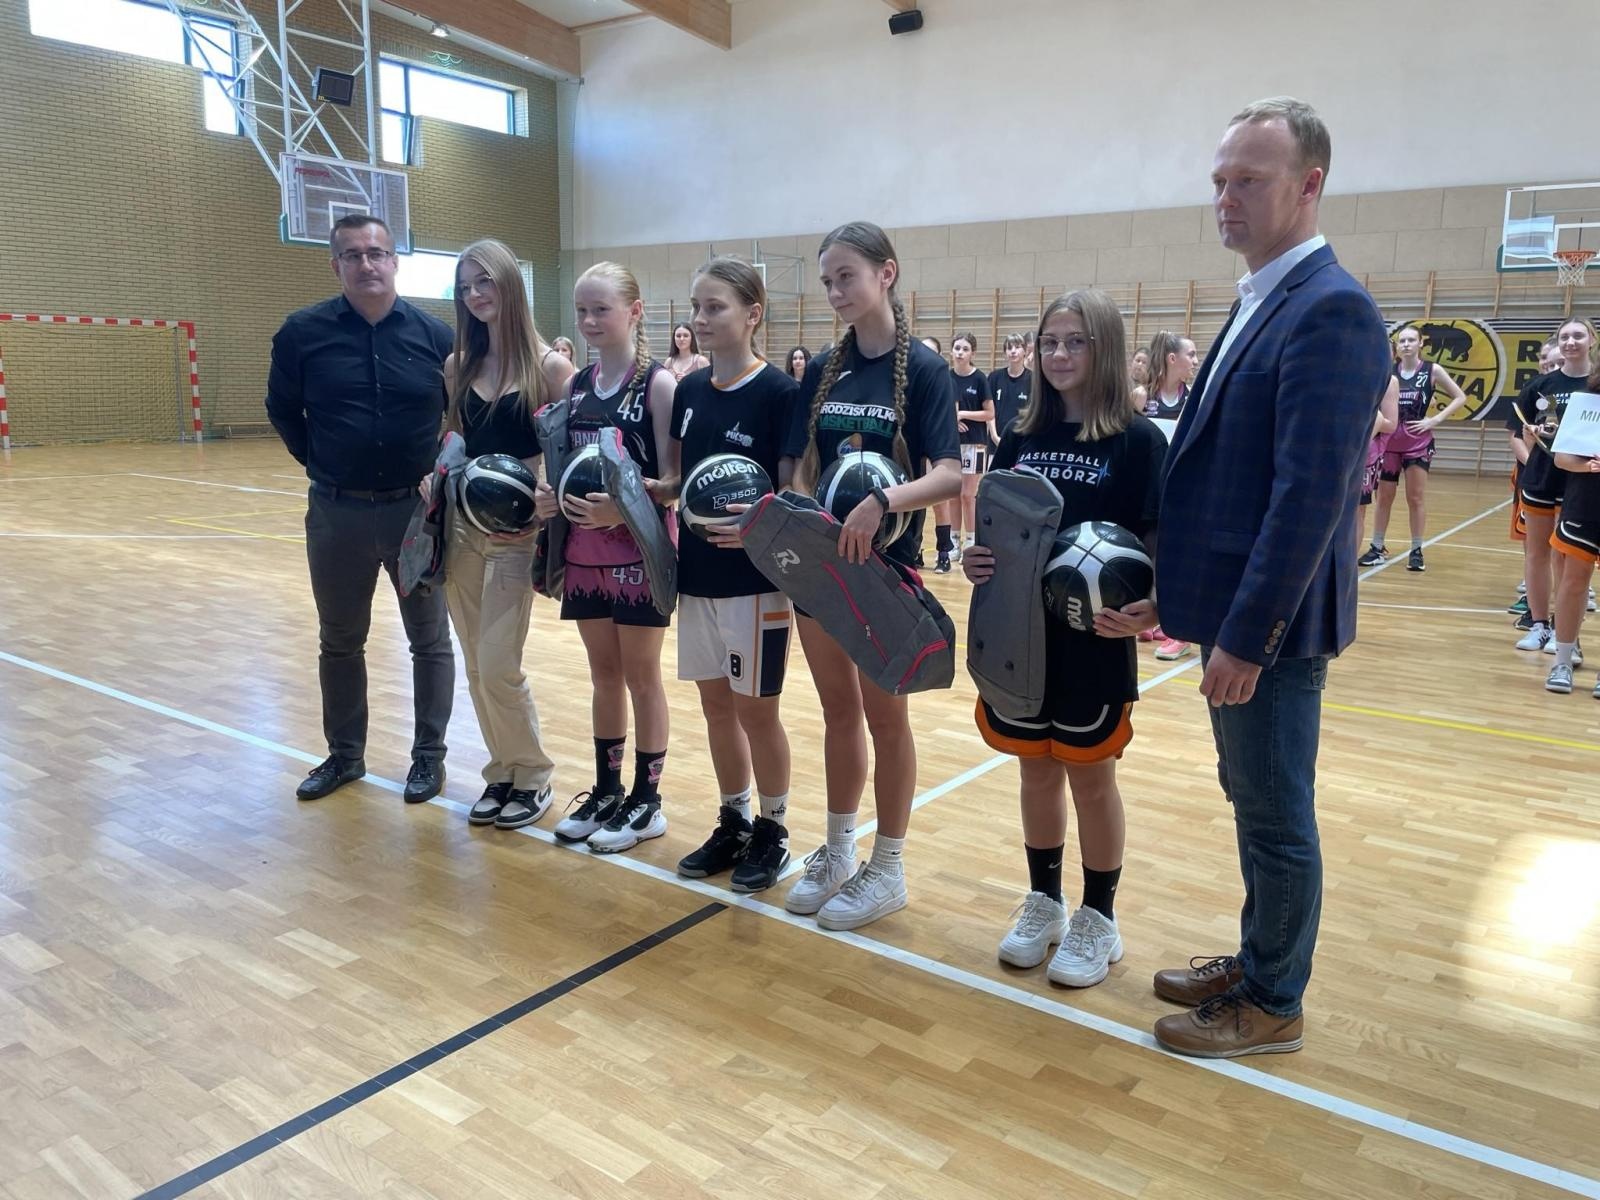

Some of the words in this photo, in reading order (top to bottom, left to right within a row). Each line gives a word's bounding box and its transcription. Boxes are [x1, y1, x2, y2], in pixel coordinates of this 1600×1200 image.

[1416, 375, 1428, 388] 27
[616, 392, 645, 422] 45
[820, 404, 866, 417] RODZISK
[731, 487, 757, 501] 3500
[612, 565, 644, 585] 45
[730, 652, 743, 679] 8
